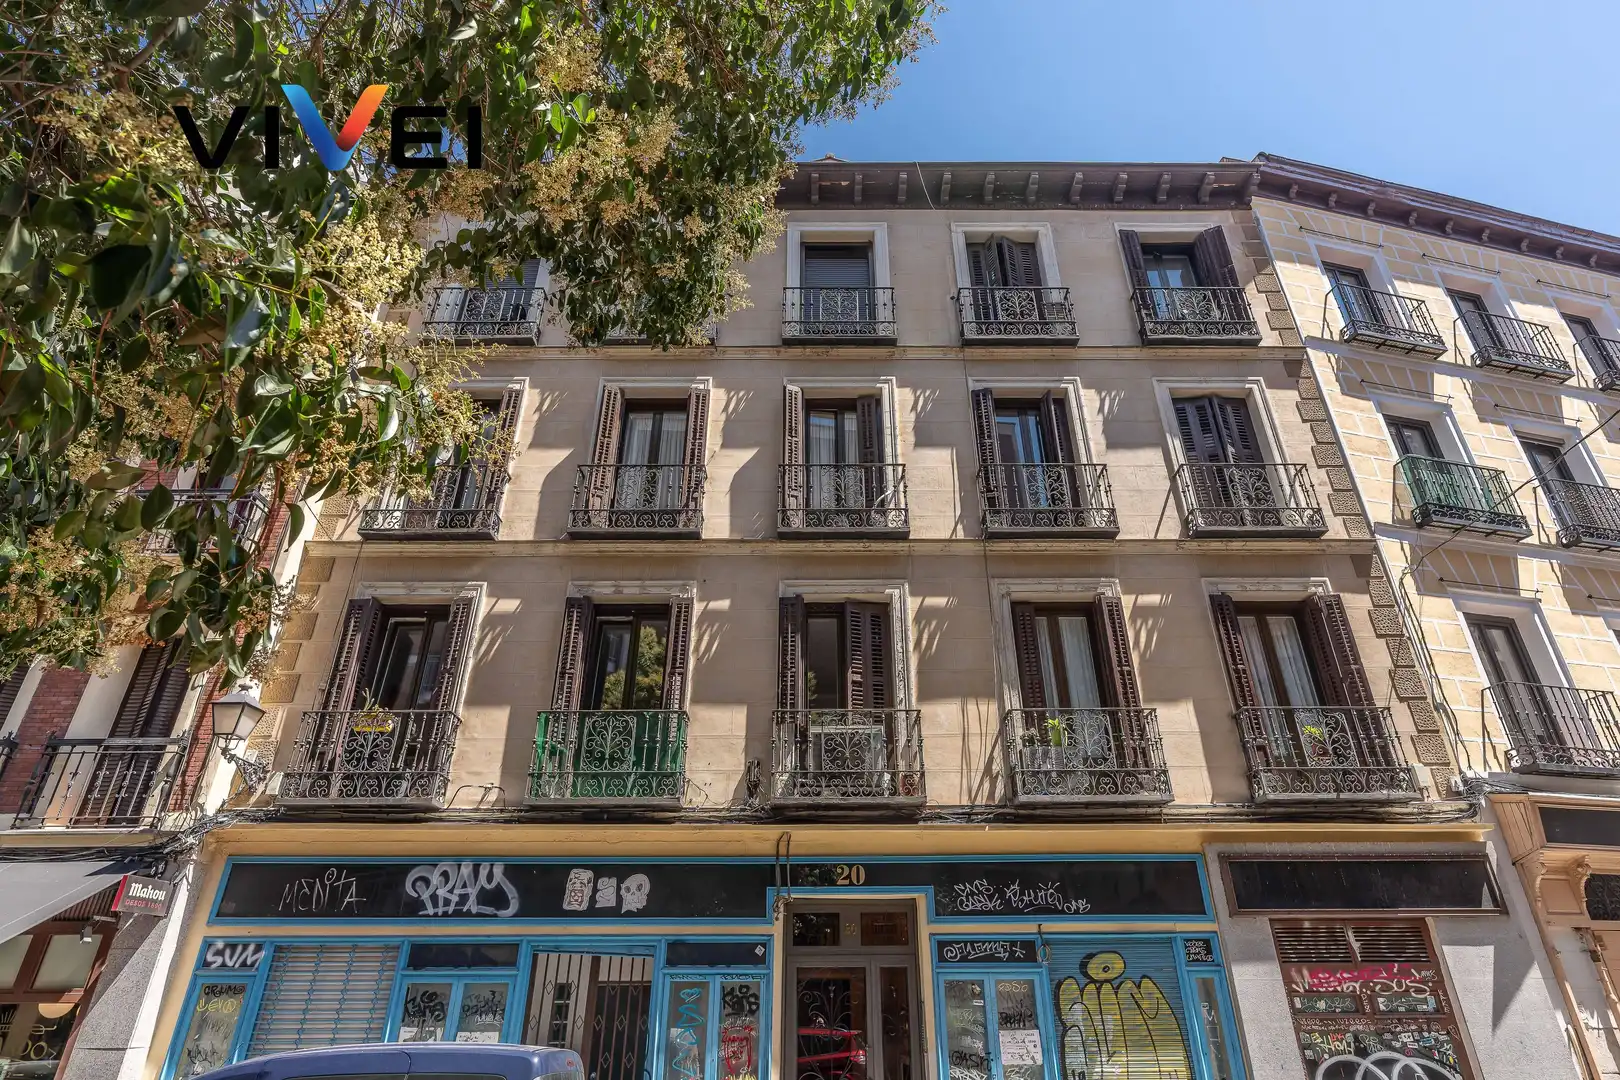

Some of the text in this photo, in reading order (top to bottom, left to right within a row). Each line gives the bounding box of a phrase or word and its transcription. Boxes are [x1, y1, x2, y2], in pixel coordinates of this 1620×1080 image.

[836, 864, 866, 885] 20
[128, 882, 167, 901] Mahou
[125, 898, 146, 908] DESDE
